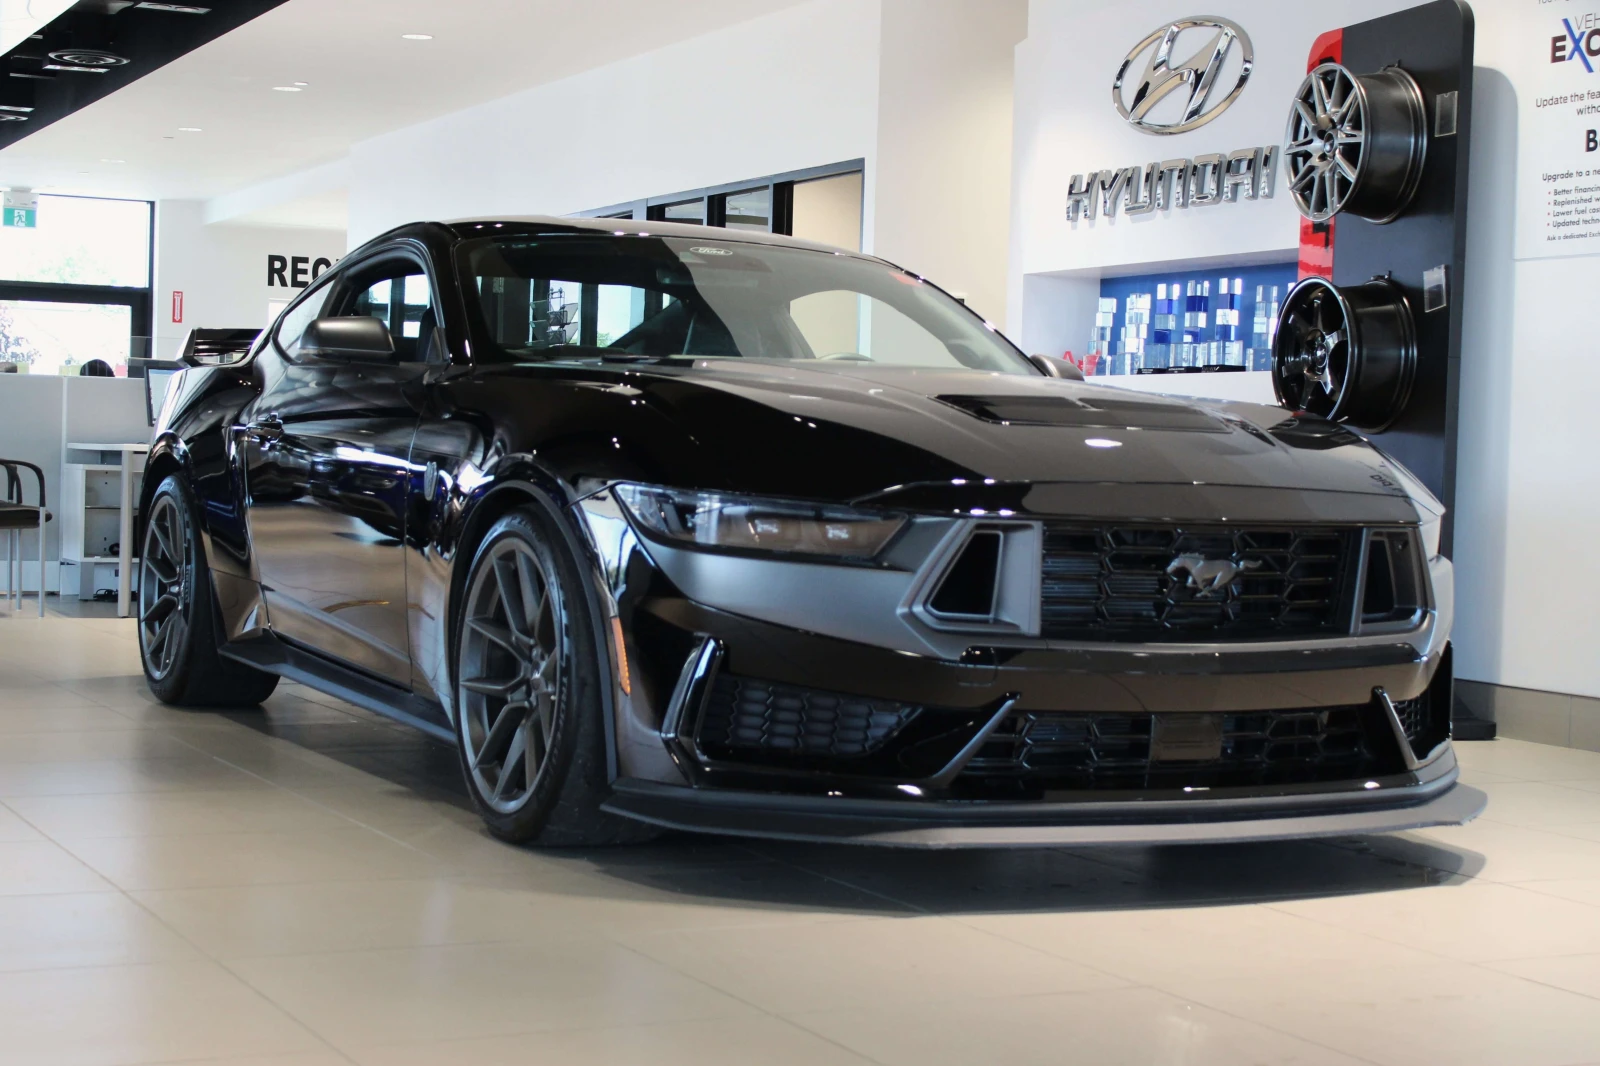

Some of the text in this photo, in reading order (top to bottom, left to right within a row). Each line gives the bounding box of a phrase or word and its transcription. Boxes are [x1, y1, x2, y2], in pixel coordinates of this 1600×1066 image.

[1536, 96, 1568, 108] Update
[1570, 92, 1585, 103] the
[1585, 129, 1600, 152] B
[1542, 170, 1573, 182] Upgrade
[1066, 145, 1279, 221] HYUNDAI
[1553, 188, 1572, 196] Better
[1553, 196, 1592, 207] Replenished
[1574, 206, 1588, 216] fuel
[1553, 218, 1580, 228] Updated
[1563, 231, 1588, 240] dedicated
